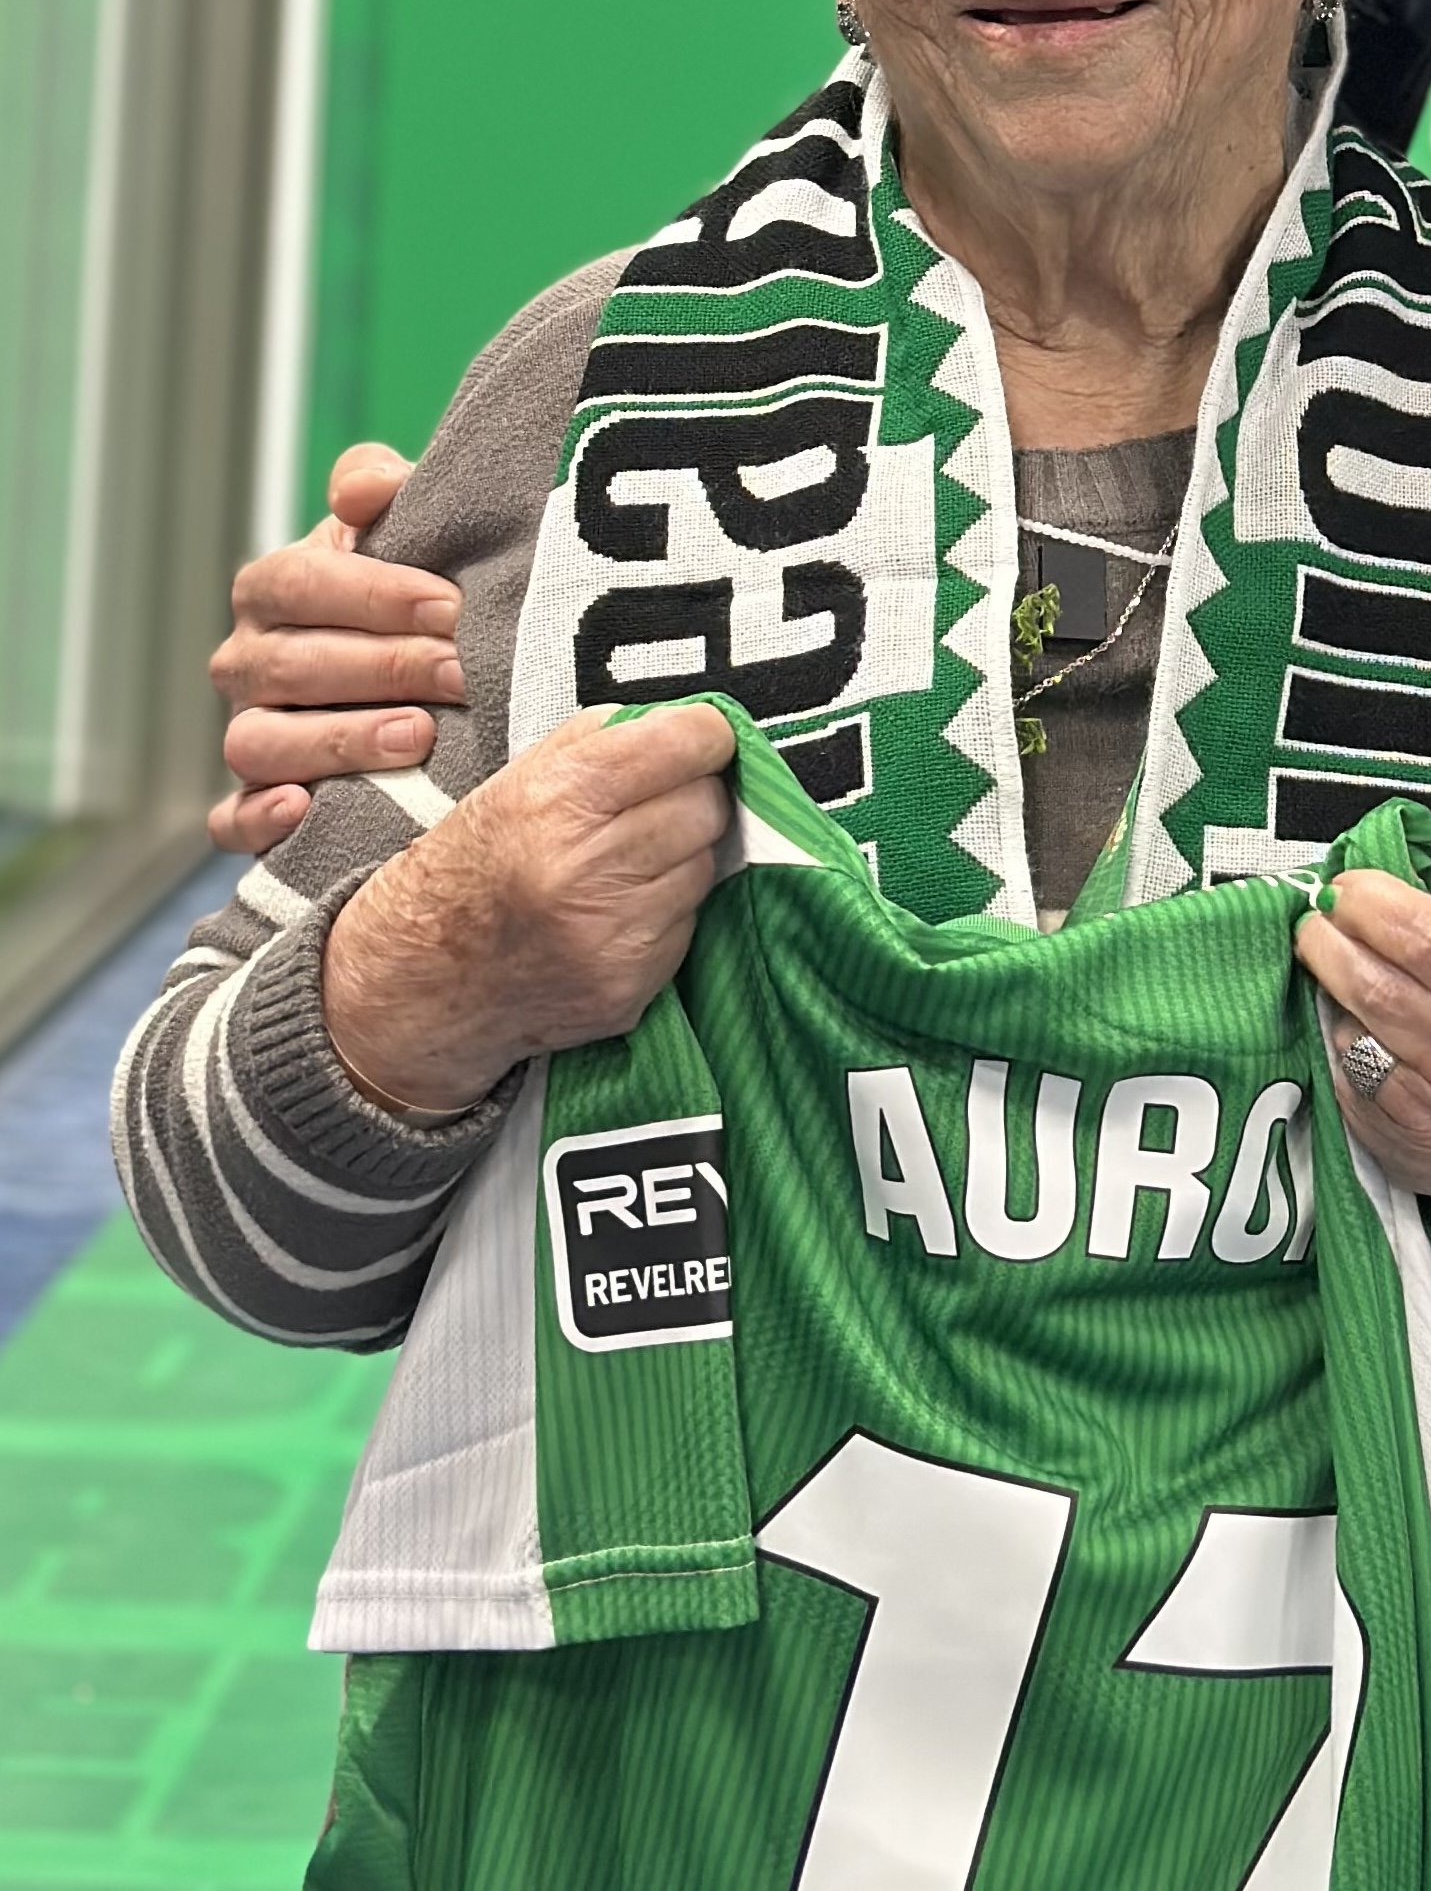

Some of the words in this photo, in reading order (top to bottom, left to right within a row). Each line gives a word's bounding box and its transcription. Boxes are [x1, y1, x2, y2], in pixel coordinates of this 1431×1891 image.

[573, 320, 886, 818] eal
[845, 1055, 1316, 1266] AURO
[584, 1255, 732, 1308] REVELRE
